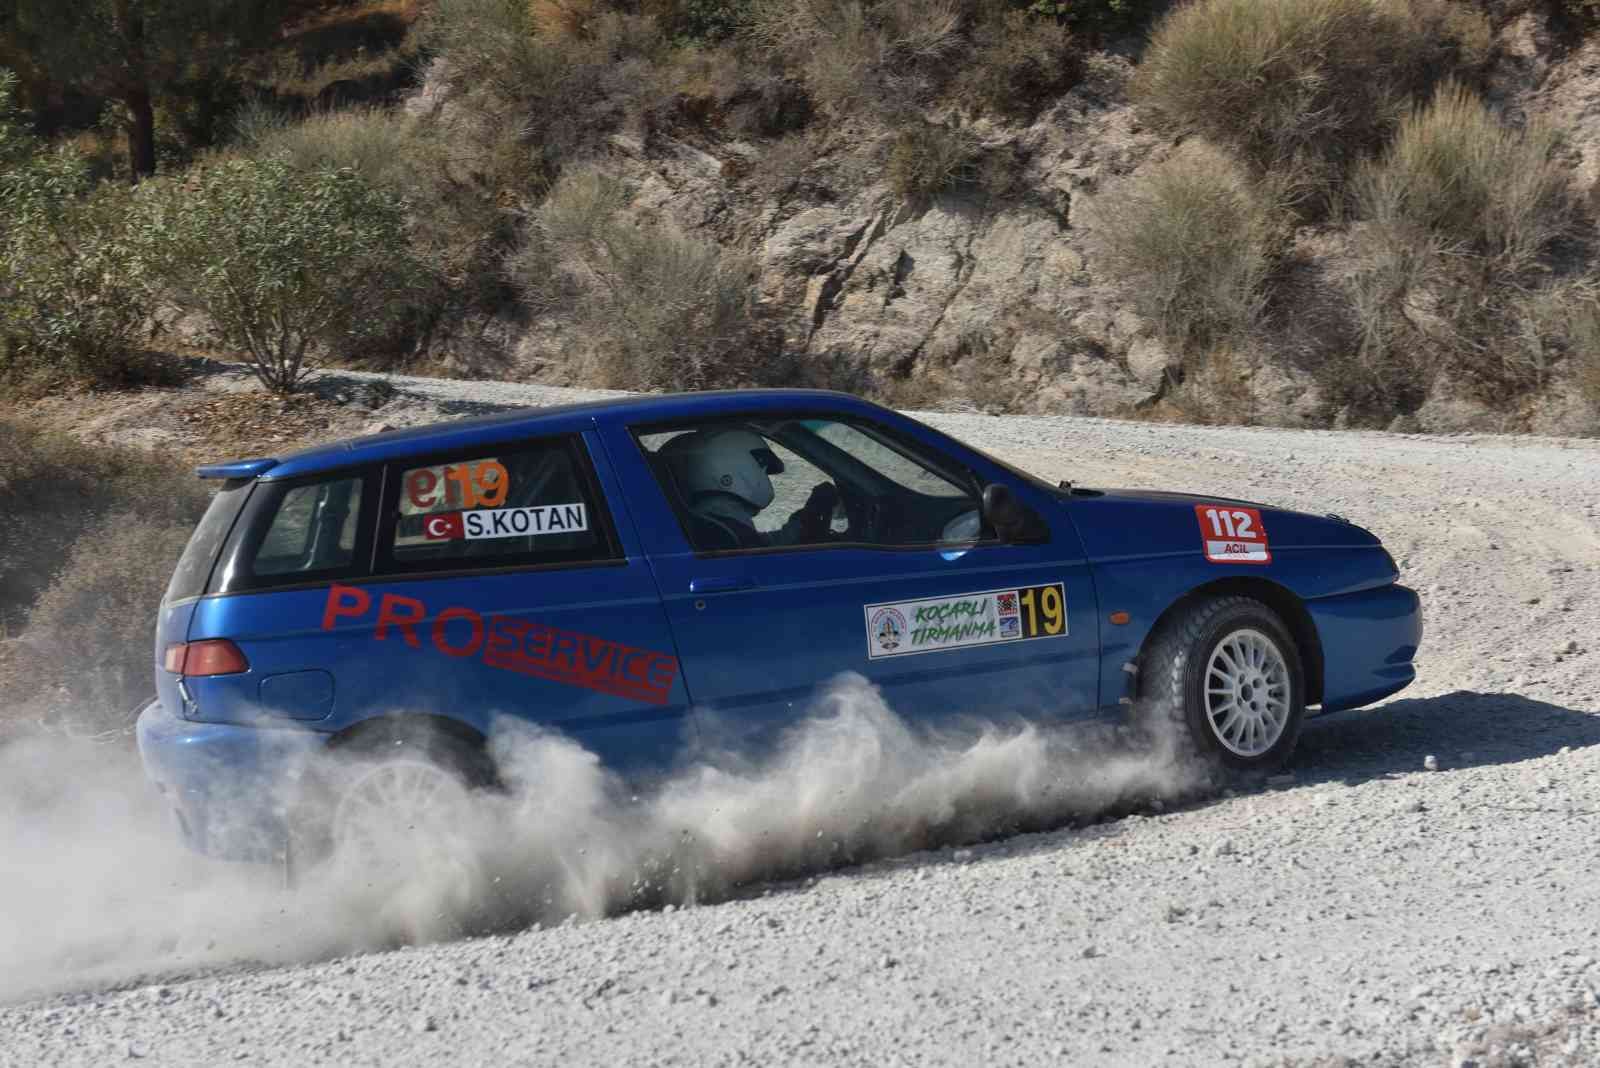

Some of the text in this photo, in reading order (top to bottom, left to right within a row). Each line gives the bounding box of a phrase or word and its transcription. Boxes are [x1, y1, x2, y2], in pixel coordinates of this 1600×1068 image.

[467, 506, 583, 536] S.KOTAN
[1206, 509, 1257, 538] 112
[1021, 587, 1063, 636] 19
[322, 583, 484, 657] PRO
[485, 614, 676, 691] SERVICE
[910, 619, 996, 645] TIRMANMA
